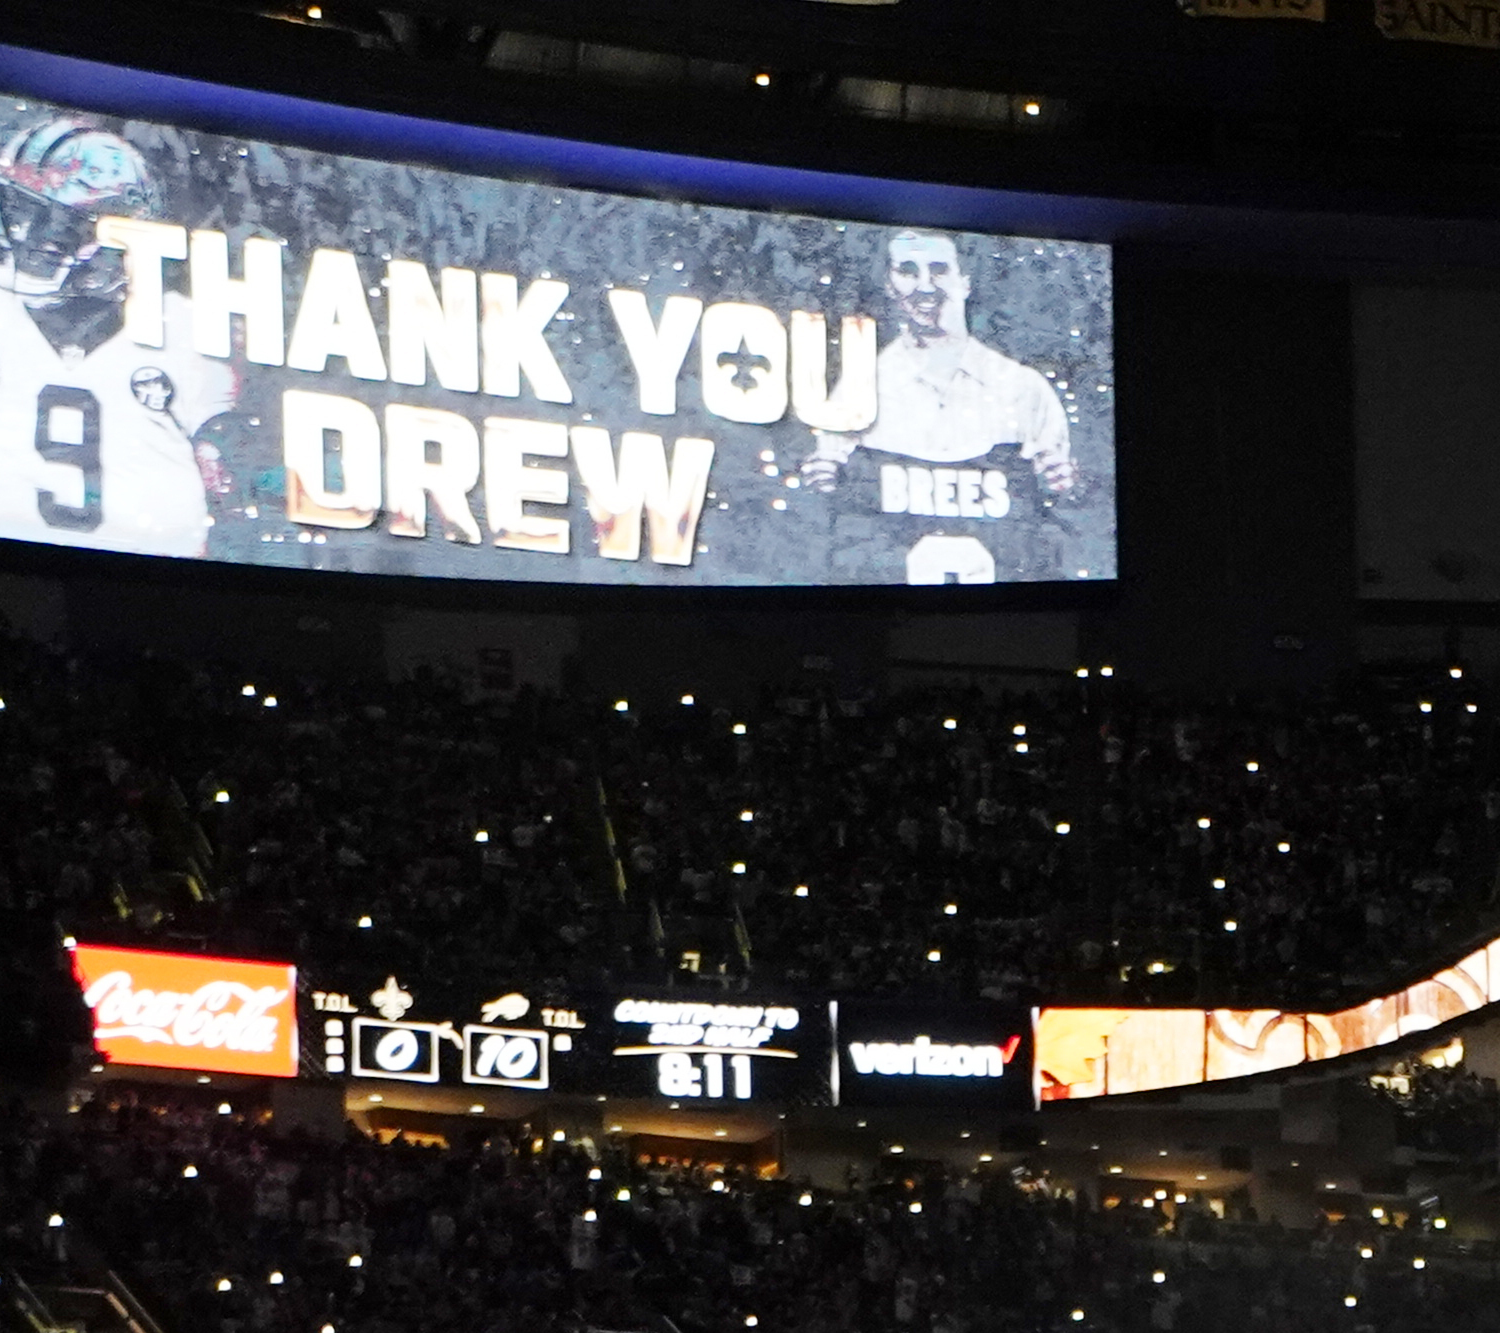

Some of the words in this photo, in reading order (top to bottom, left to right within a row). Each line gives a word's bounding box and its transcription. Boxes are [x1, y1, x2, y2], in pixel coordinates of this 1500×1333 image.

[97, 215, 572, 403] THANK
[607, 285, 878, 433] YOU
[33, 383, 101, 530] 9
[281, 388, 714, 567] DREW
[881, 464, 1010, 519] BREES
[476, 1034, 538, 1078] 10
[658, 1052, 752, 1099] 8:11
[849, 1035, 1003, 1077] verizon
